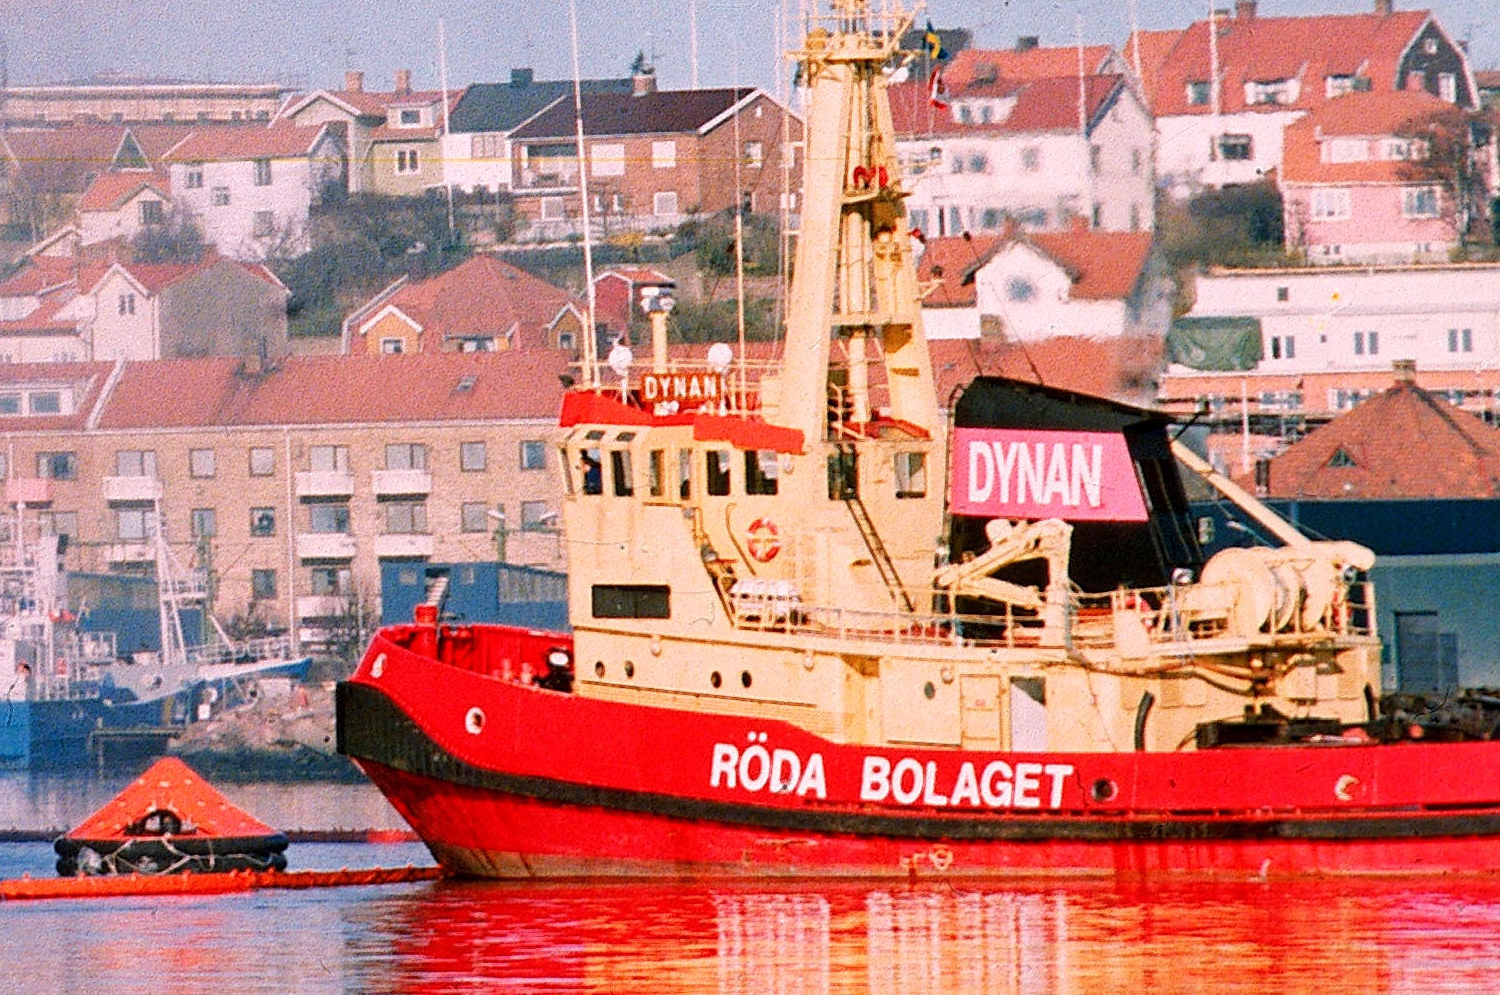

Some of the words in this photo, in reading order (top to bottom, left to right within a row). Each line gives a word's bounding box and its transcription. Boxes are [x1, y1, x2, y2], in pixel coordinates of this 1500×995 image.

[644, 375, 717, 399] DYNAN
[968, 440, 1103, 507] DYNAN
[710, 731, 828, 799] RÖDA
[860, 755, 1074, 809] BOLAGET
